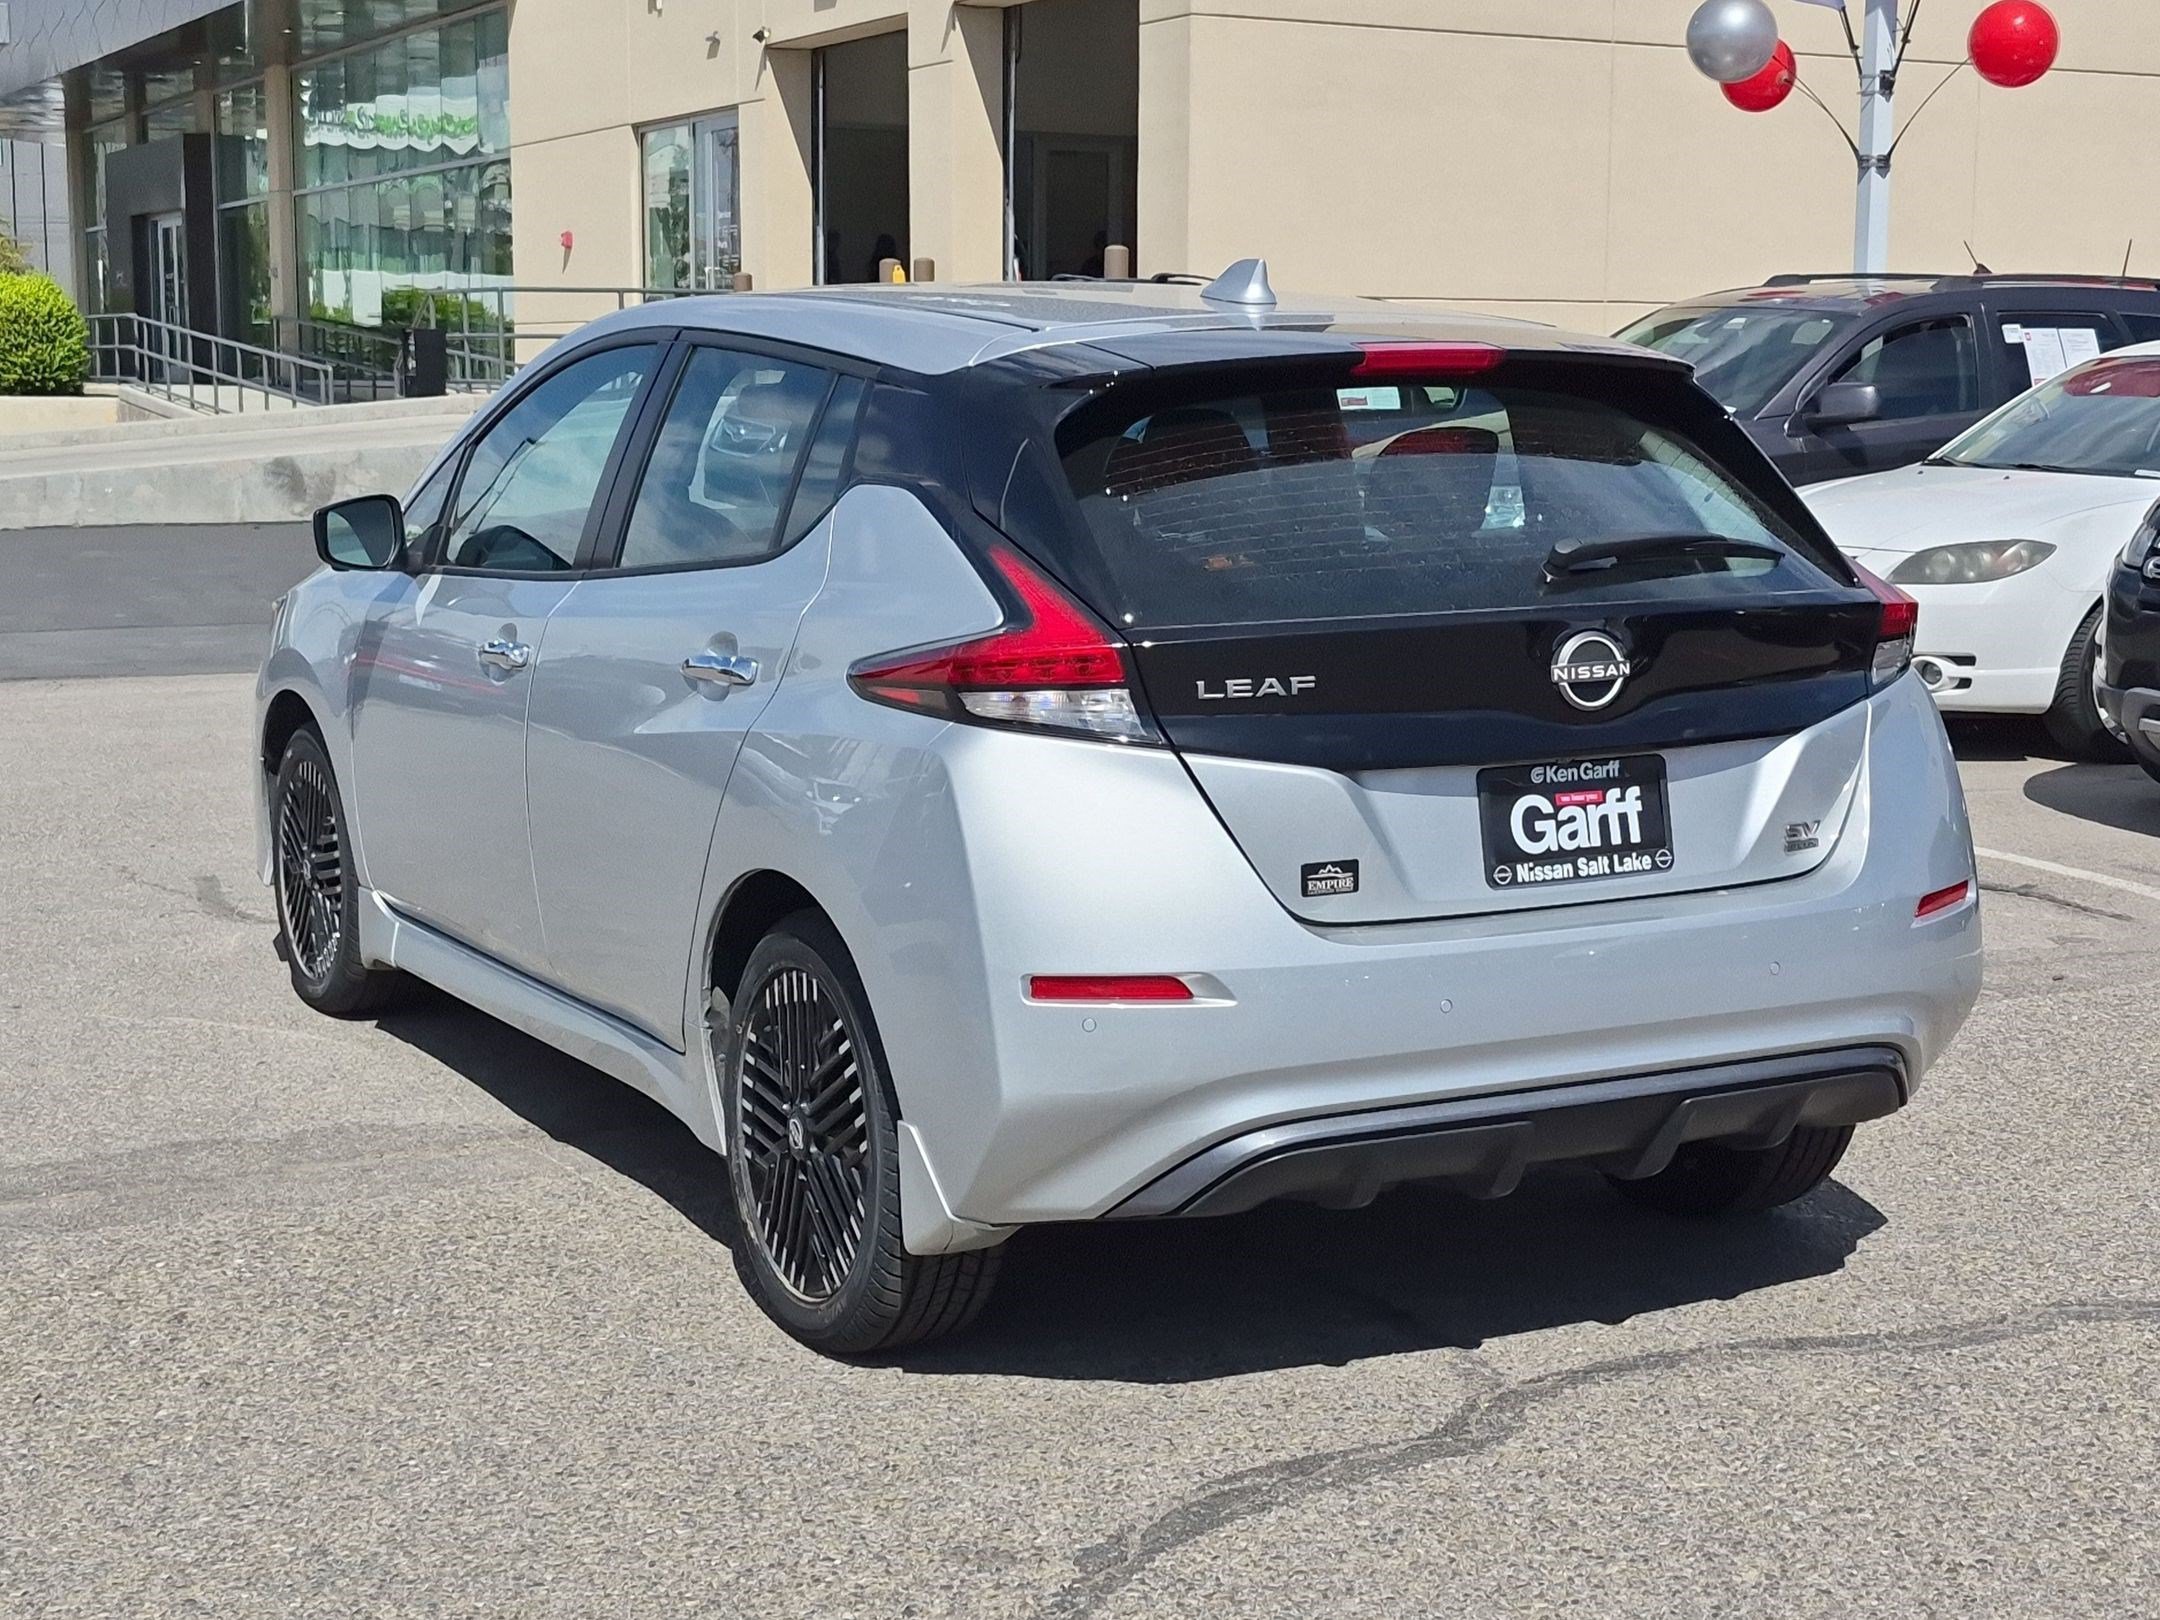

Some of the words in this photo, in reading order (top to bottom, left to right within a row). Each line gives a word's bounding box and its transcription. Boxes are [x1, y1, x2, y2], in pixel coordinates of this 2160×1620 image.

[1553, 663, 1630, 680] NISSAN
[1196, 676, 1316, 699] LEAF
[1545, 765, 1578, 783] Ken
[1580, 760, 1620, 780] Garff
[1510, 786, 1643, 855] Garff
[1516, 862, 1574, 883] Nissan
[1577, 856, 1611, 876] Salt
[1613, 852, 1652, 872] Lake
[1307, 877, 1354, 891] EMPIRE
